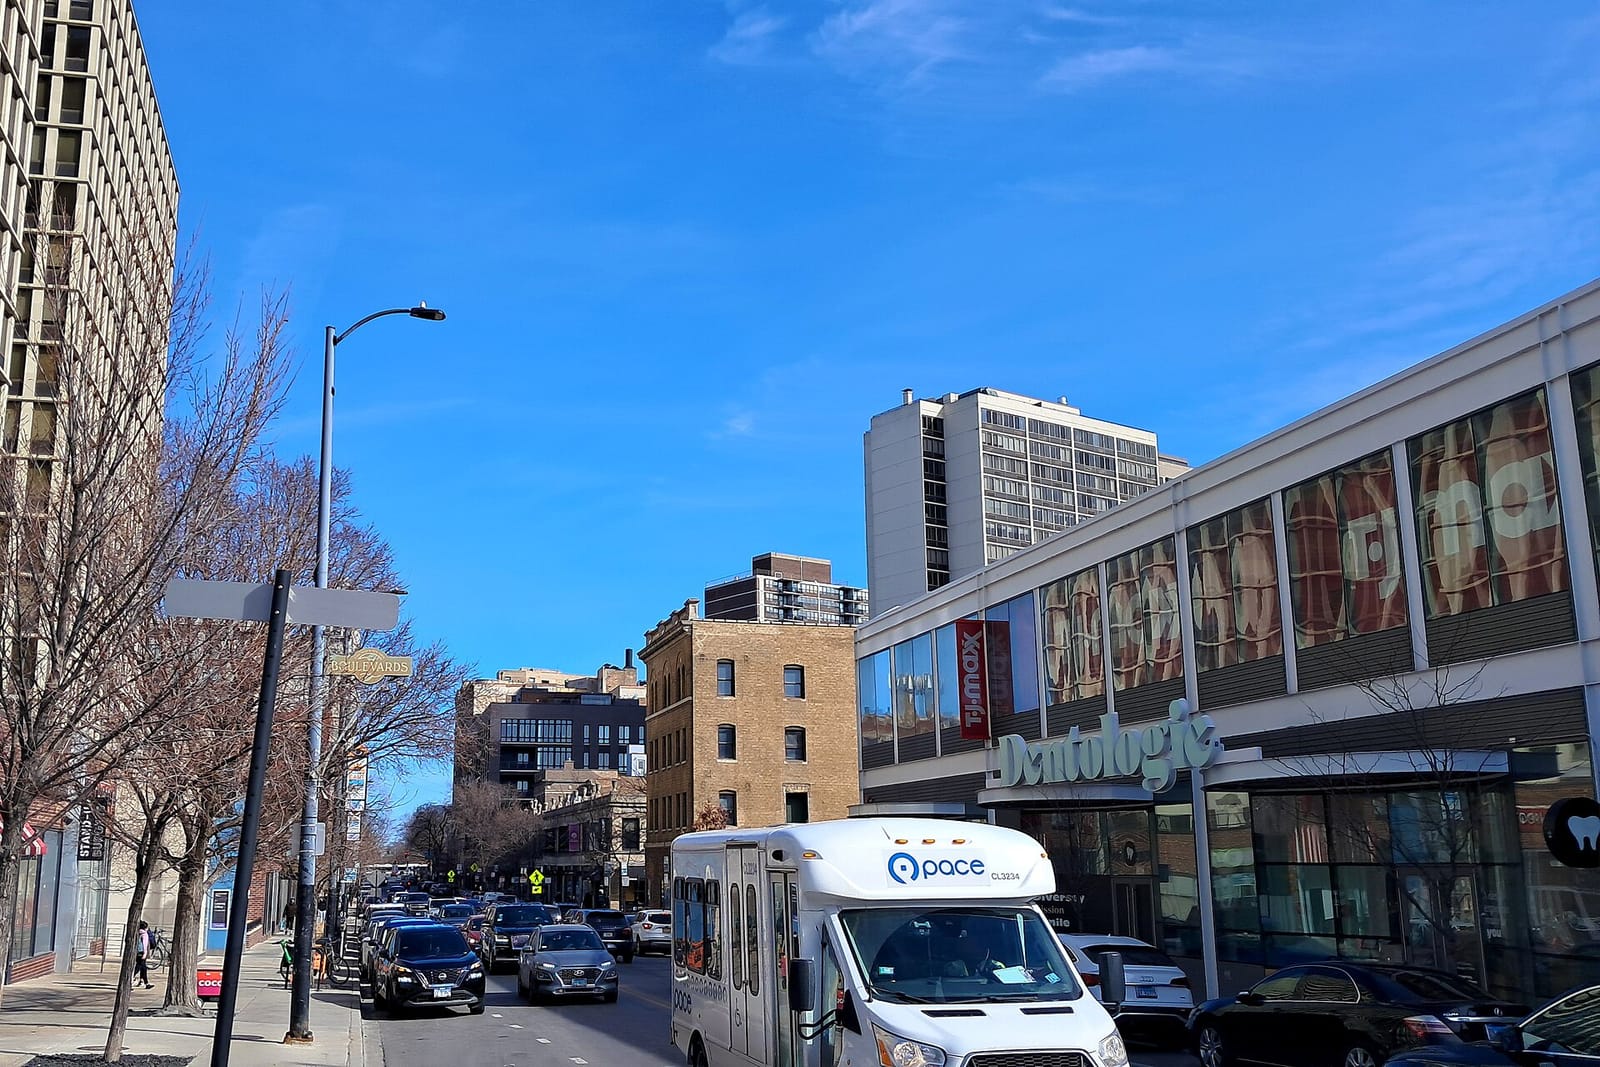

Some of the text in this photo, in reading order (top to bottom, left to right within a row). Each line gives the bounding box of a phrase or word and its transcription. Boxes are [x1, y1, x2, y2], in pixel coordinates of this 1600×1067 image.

[331, 660, 409, 673] BOULEVARDS
[997, 698, 1216, 794] Dentologie
[922, 859, 985, 879] pace
[991, 872, 1020, 881] CL3234
